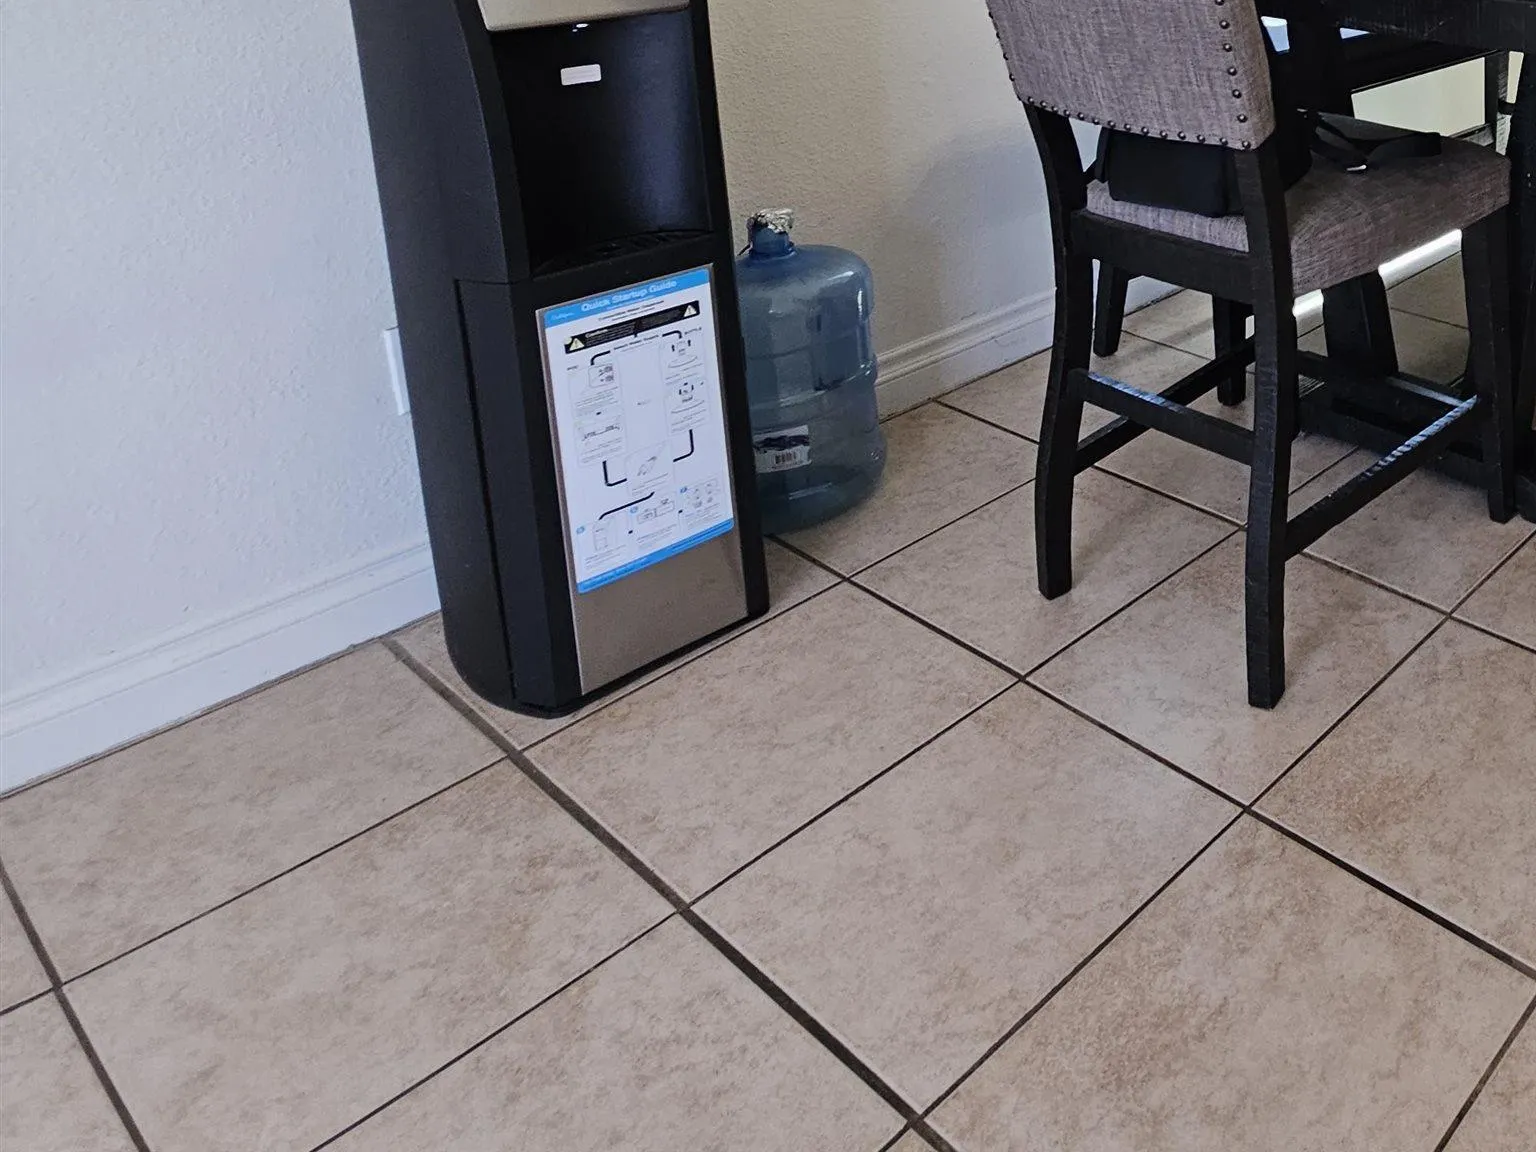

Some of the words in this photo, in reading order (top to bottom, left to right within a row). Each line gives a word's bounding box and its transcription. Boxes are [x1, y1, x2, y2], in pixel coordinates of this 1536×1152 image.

[581, 299, 611, 312] Quick
[611, 288, 648, 303] Startup
[649, 279, 677, 294] Guide
